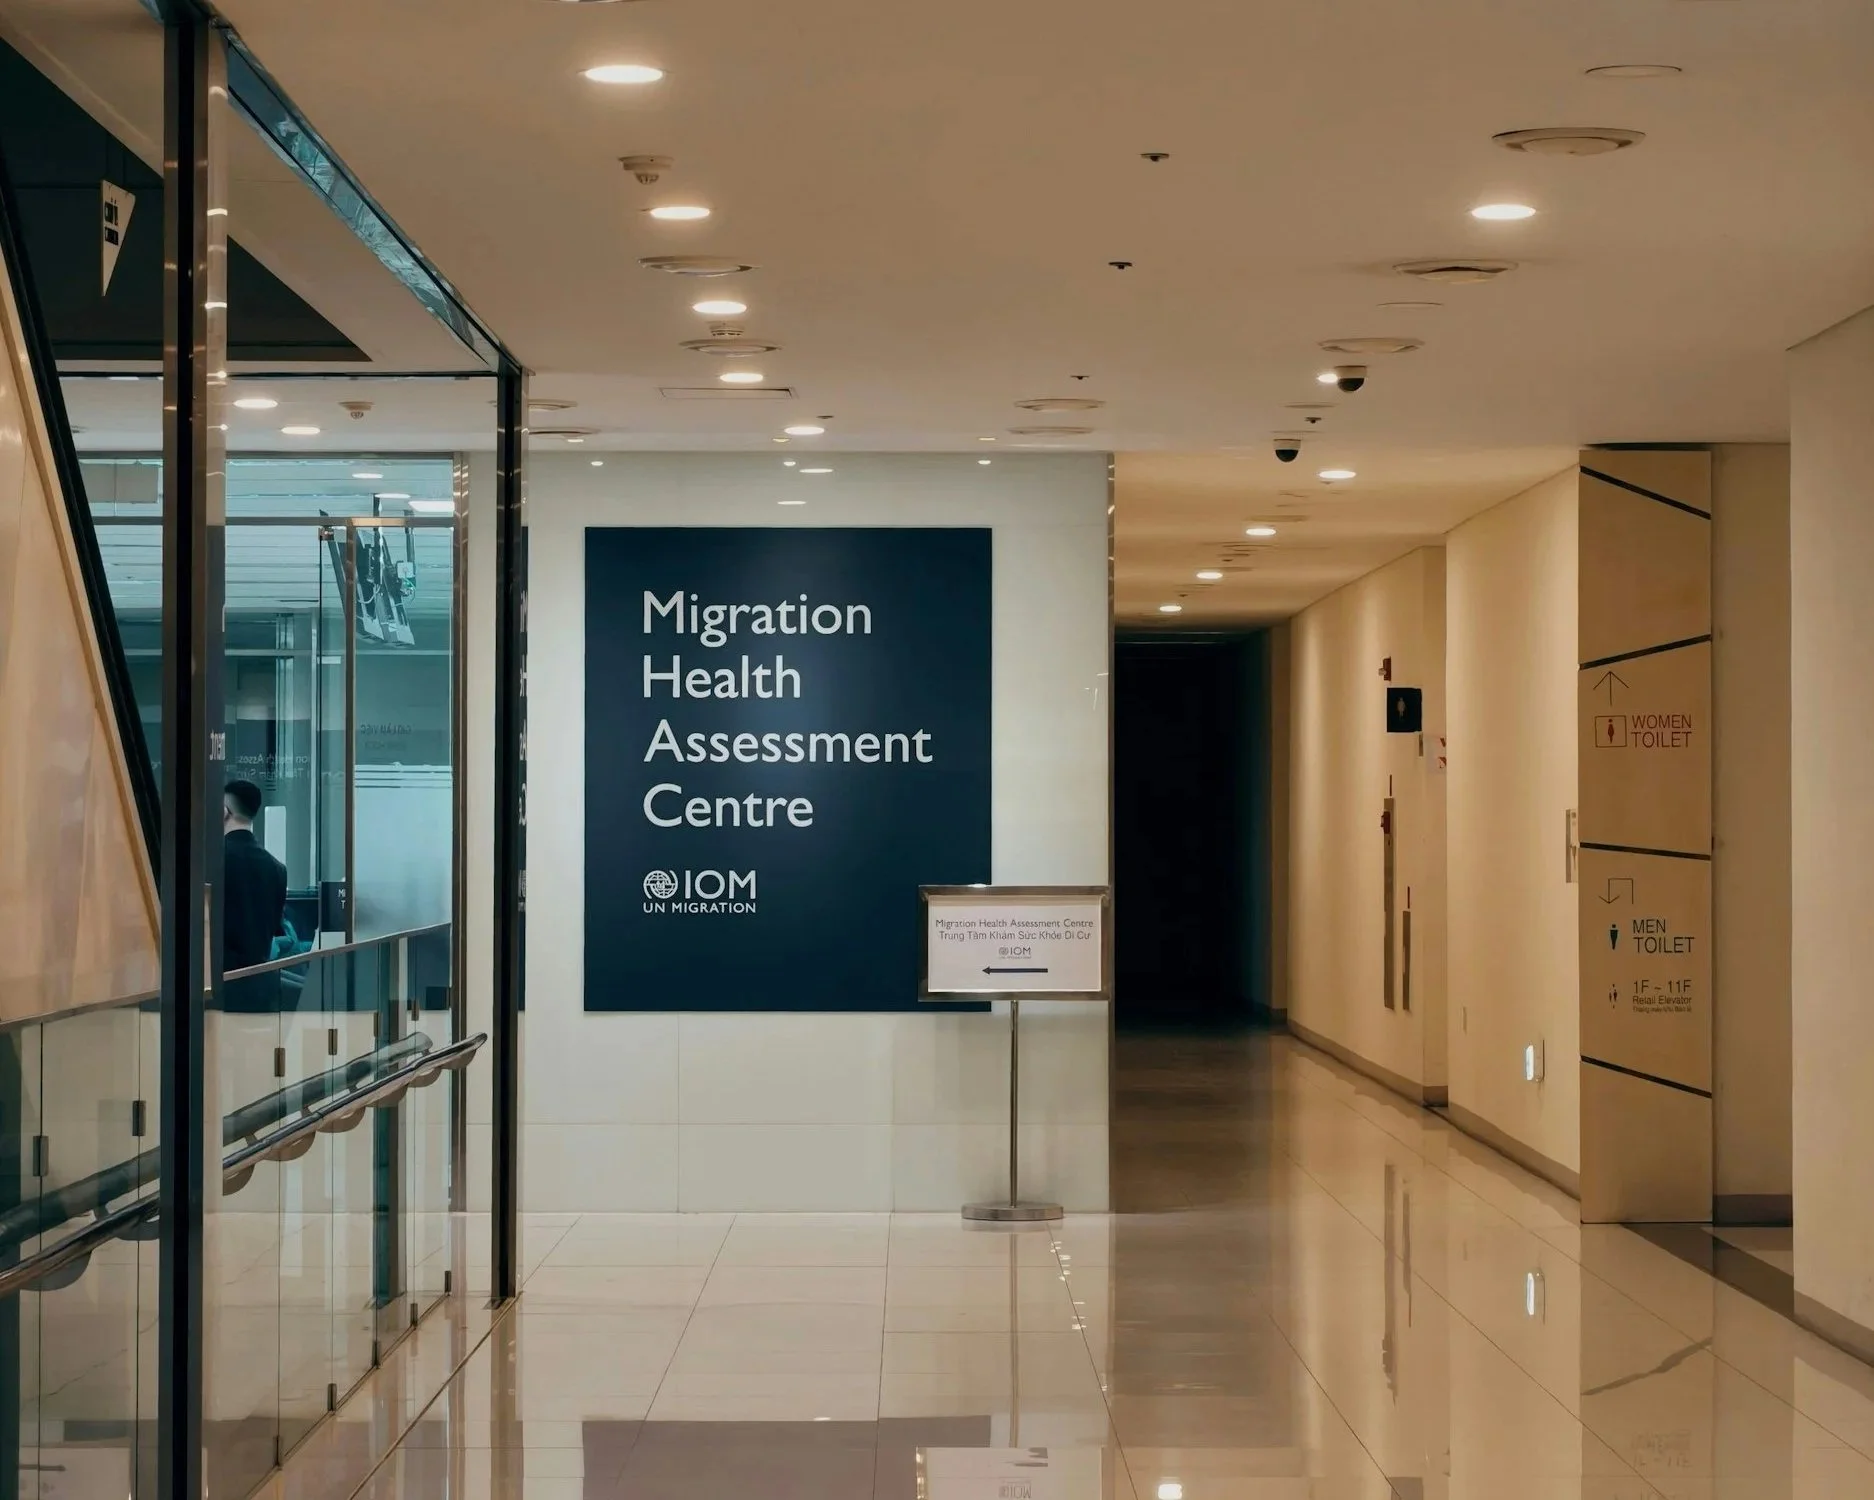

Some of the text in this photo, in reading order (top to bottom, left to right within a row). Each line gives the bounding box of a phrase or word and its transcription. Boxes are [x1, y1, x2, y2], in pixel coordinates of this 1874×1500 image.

[643, 590, 872, 648] Migration
[643, 655, 801, 698] Health
[1632, 714, 1692, 730] WOMEN
[643, 718, 934, 764] Assessment
[1631, 731, 1693, 748] TOILET
[643, 783, 814, 828] Centre
[685, 870, 757, 900] IOM
[643, 902, 757, 914] UN MIGRATION
[935, 918, 1094, 930] Migration Health Assessment Centre
[1632, 919, 1667, 934] MEN
[939, 931, 965, 942] Trung
[1065, 931, 1075, 940] Di
[1010, 946, 1031, 955] IOM
[1632, 936, 1695, 954] TOILET
[1633, 980, 1650, 994] 1F
[1668, 979, 1692, 993] 11F
[1632, 995, 1692, 1005] Retail Elevator
